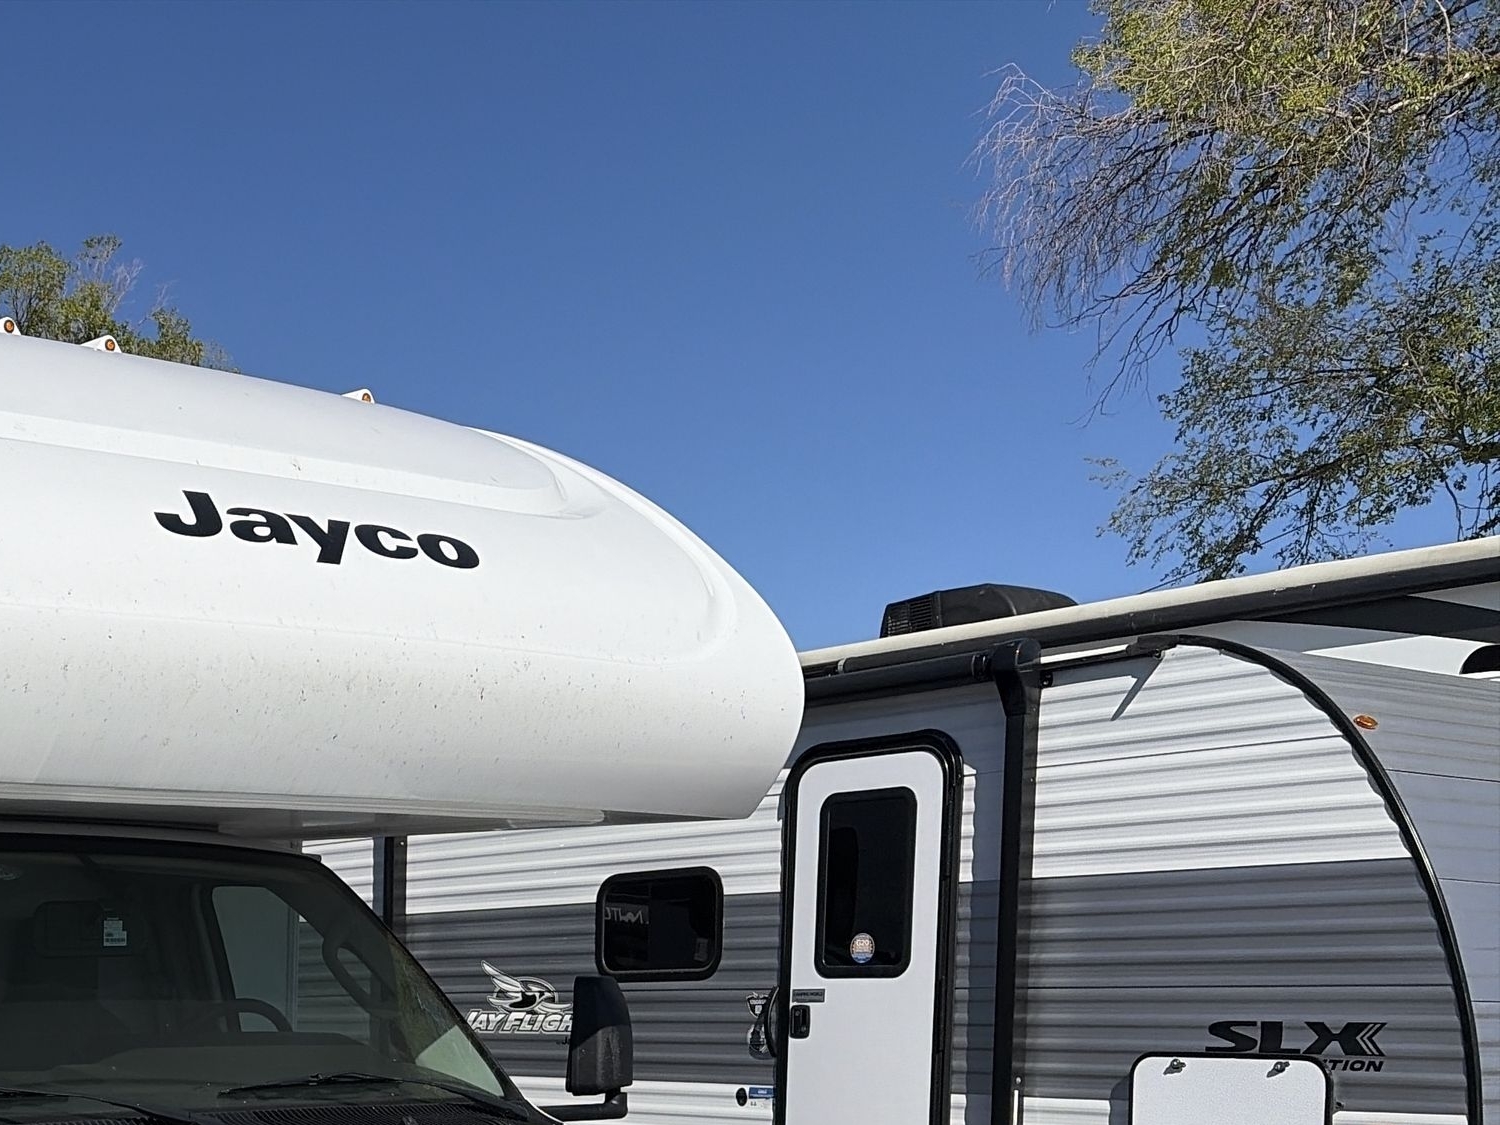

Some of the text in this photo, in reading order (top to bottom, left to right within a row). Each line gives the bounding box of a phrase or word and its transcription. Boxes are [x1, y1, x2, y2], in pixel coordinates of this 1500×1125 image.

[153, 489, 480, 570] Jayco
[503, 1011, 573, 1032] FLIGH
[1204, 1020, 1388, 1056] SLX
[1321, 1059, 1385, 1073] TION
